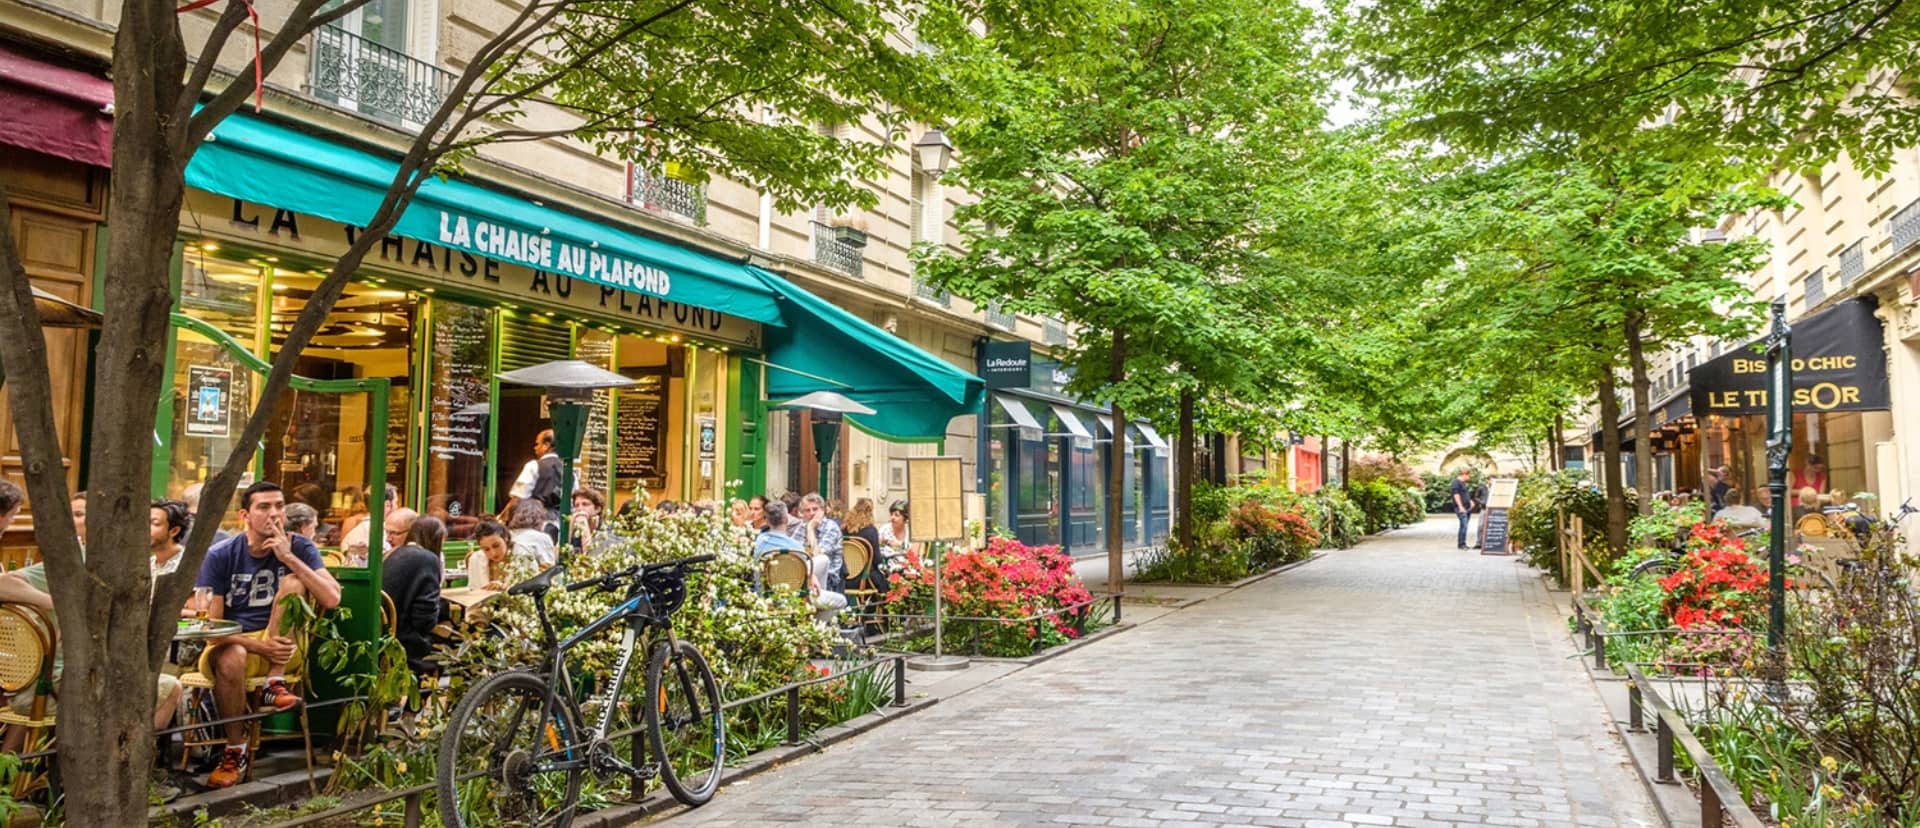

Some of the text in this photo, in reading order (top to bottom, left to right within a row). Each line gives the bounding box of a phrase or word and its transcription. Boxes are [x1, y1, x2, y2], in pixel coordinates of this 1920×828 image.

[231, 198, 300, 240] LA
[530, 270, 571, 297] AU
[440, 211, 671, 296] LA CHAISE AU PLAFOND
[987, 358, 1027, 367] La Redoute
[1733, 355, 1856, 375] BISO CHIC
[1709, 382, 1860, 410] LE TSOR
[596, 648, 627, 729] ROCKRIDER
